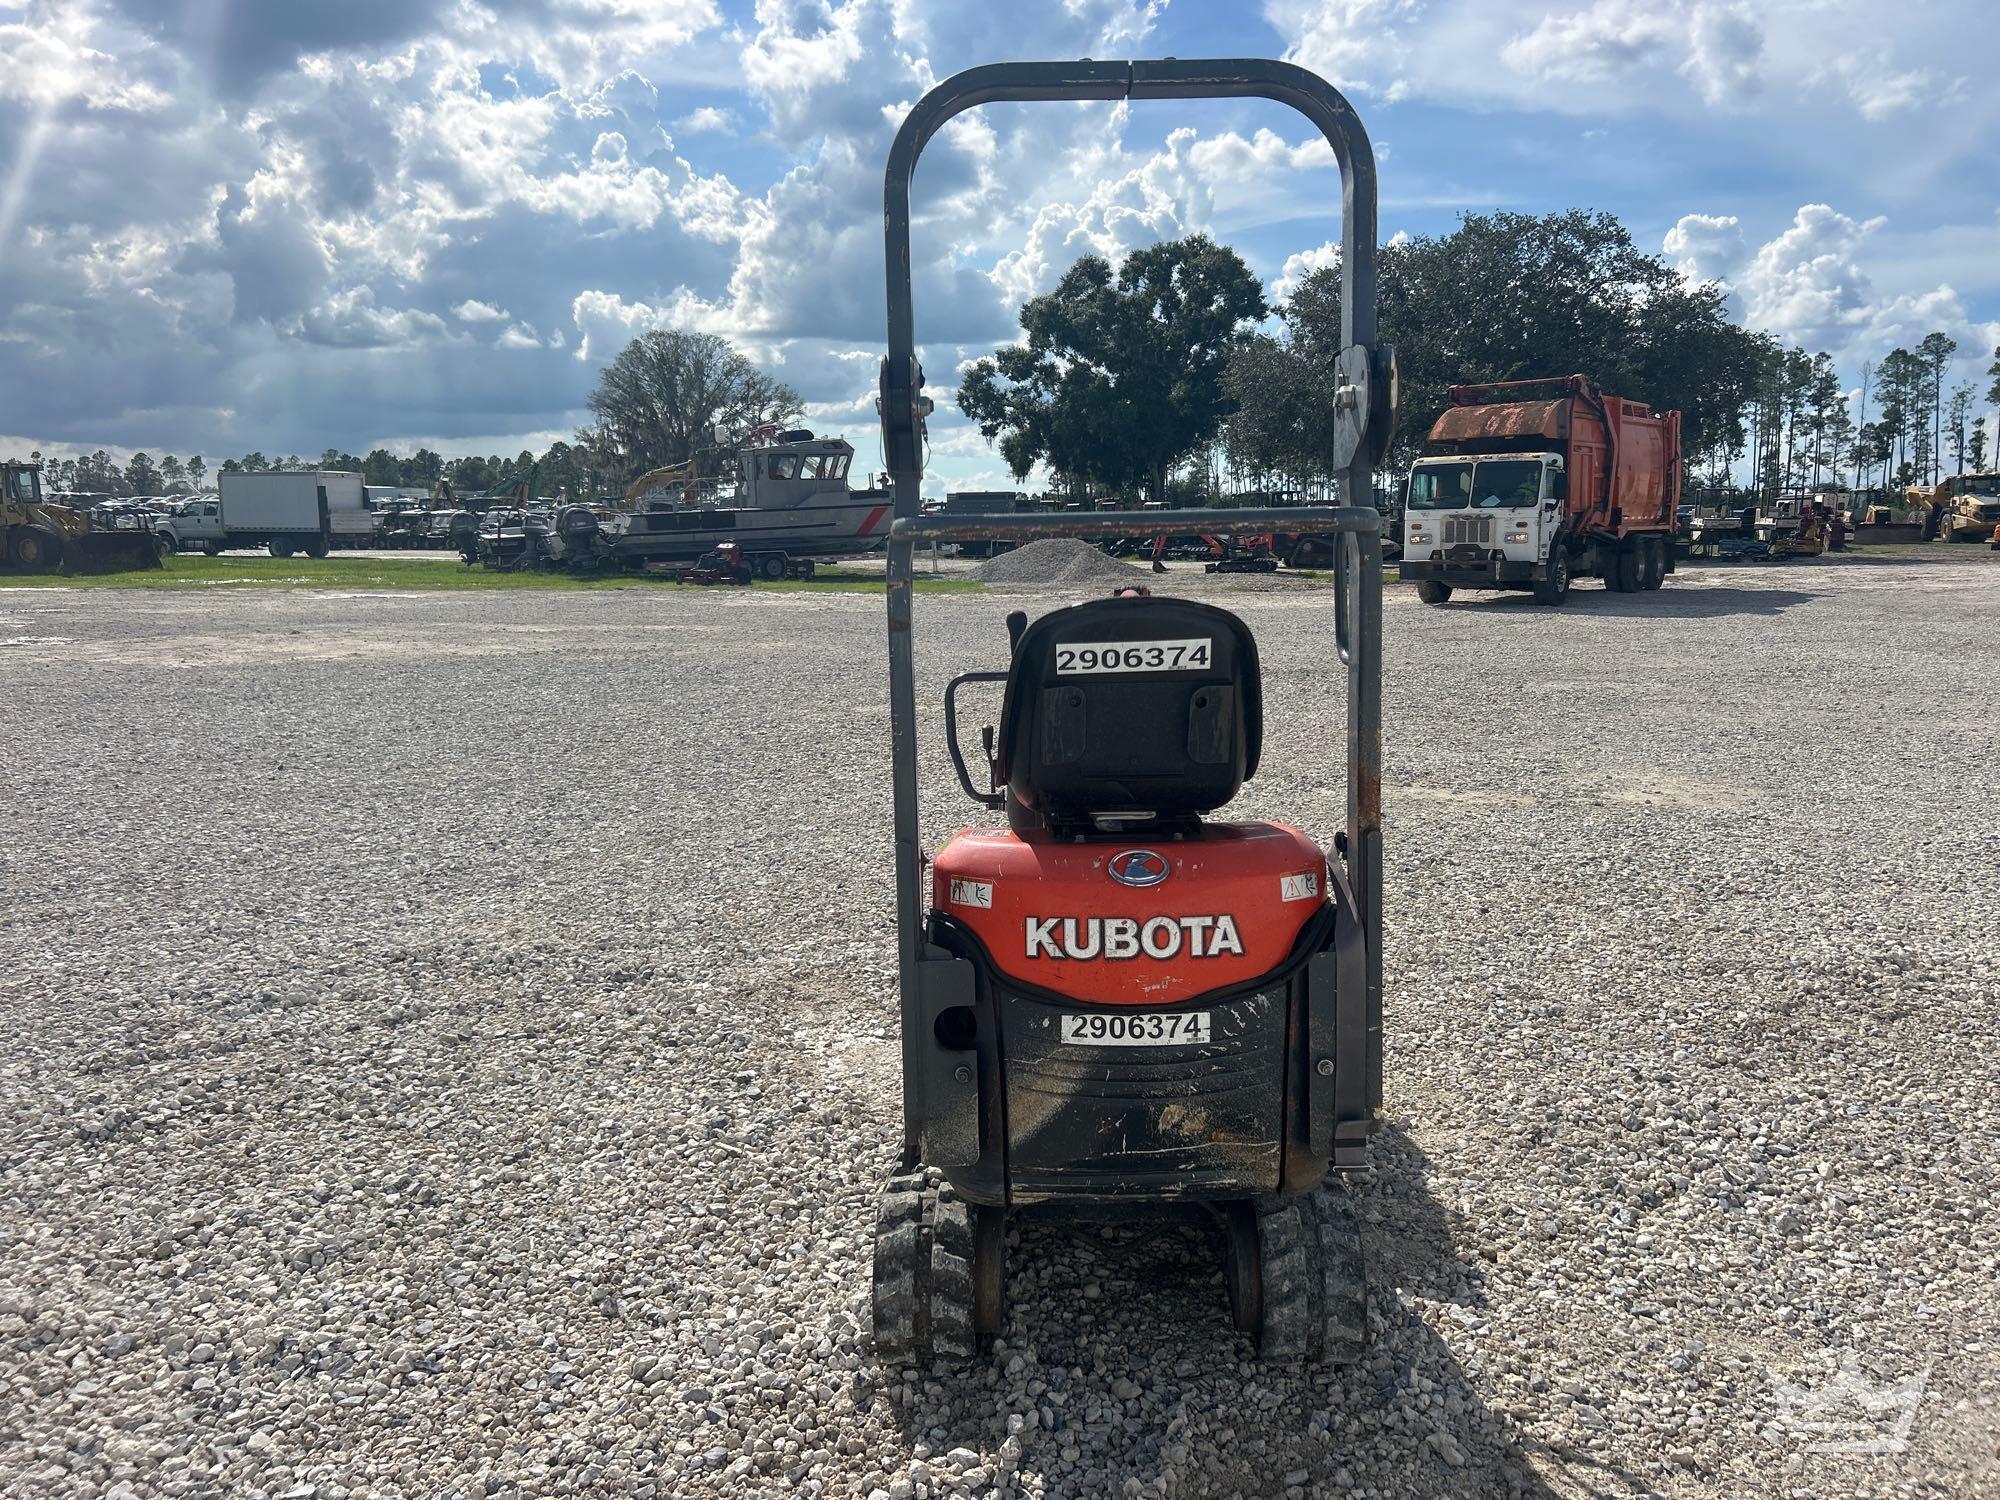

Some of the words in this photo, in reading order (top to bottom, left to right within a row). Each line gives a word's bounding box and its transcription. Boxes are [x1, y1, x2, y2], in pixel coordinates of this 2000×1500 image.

[1057, 645, 1209, 671] 2906374
[1025, 914, 1244, 960] KUBOTA
[1071, 1014, 1202, 1039] 2906374
